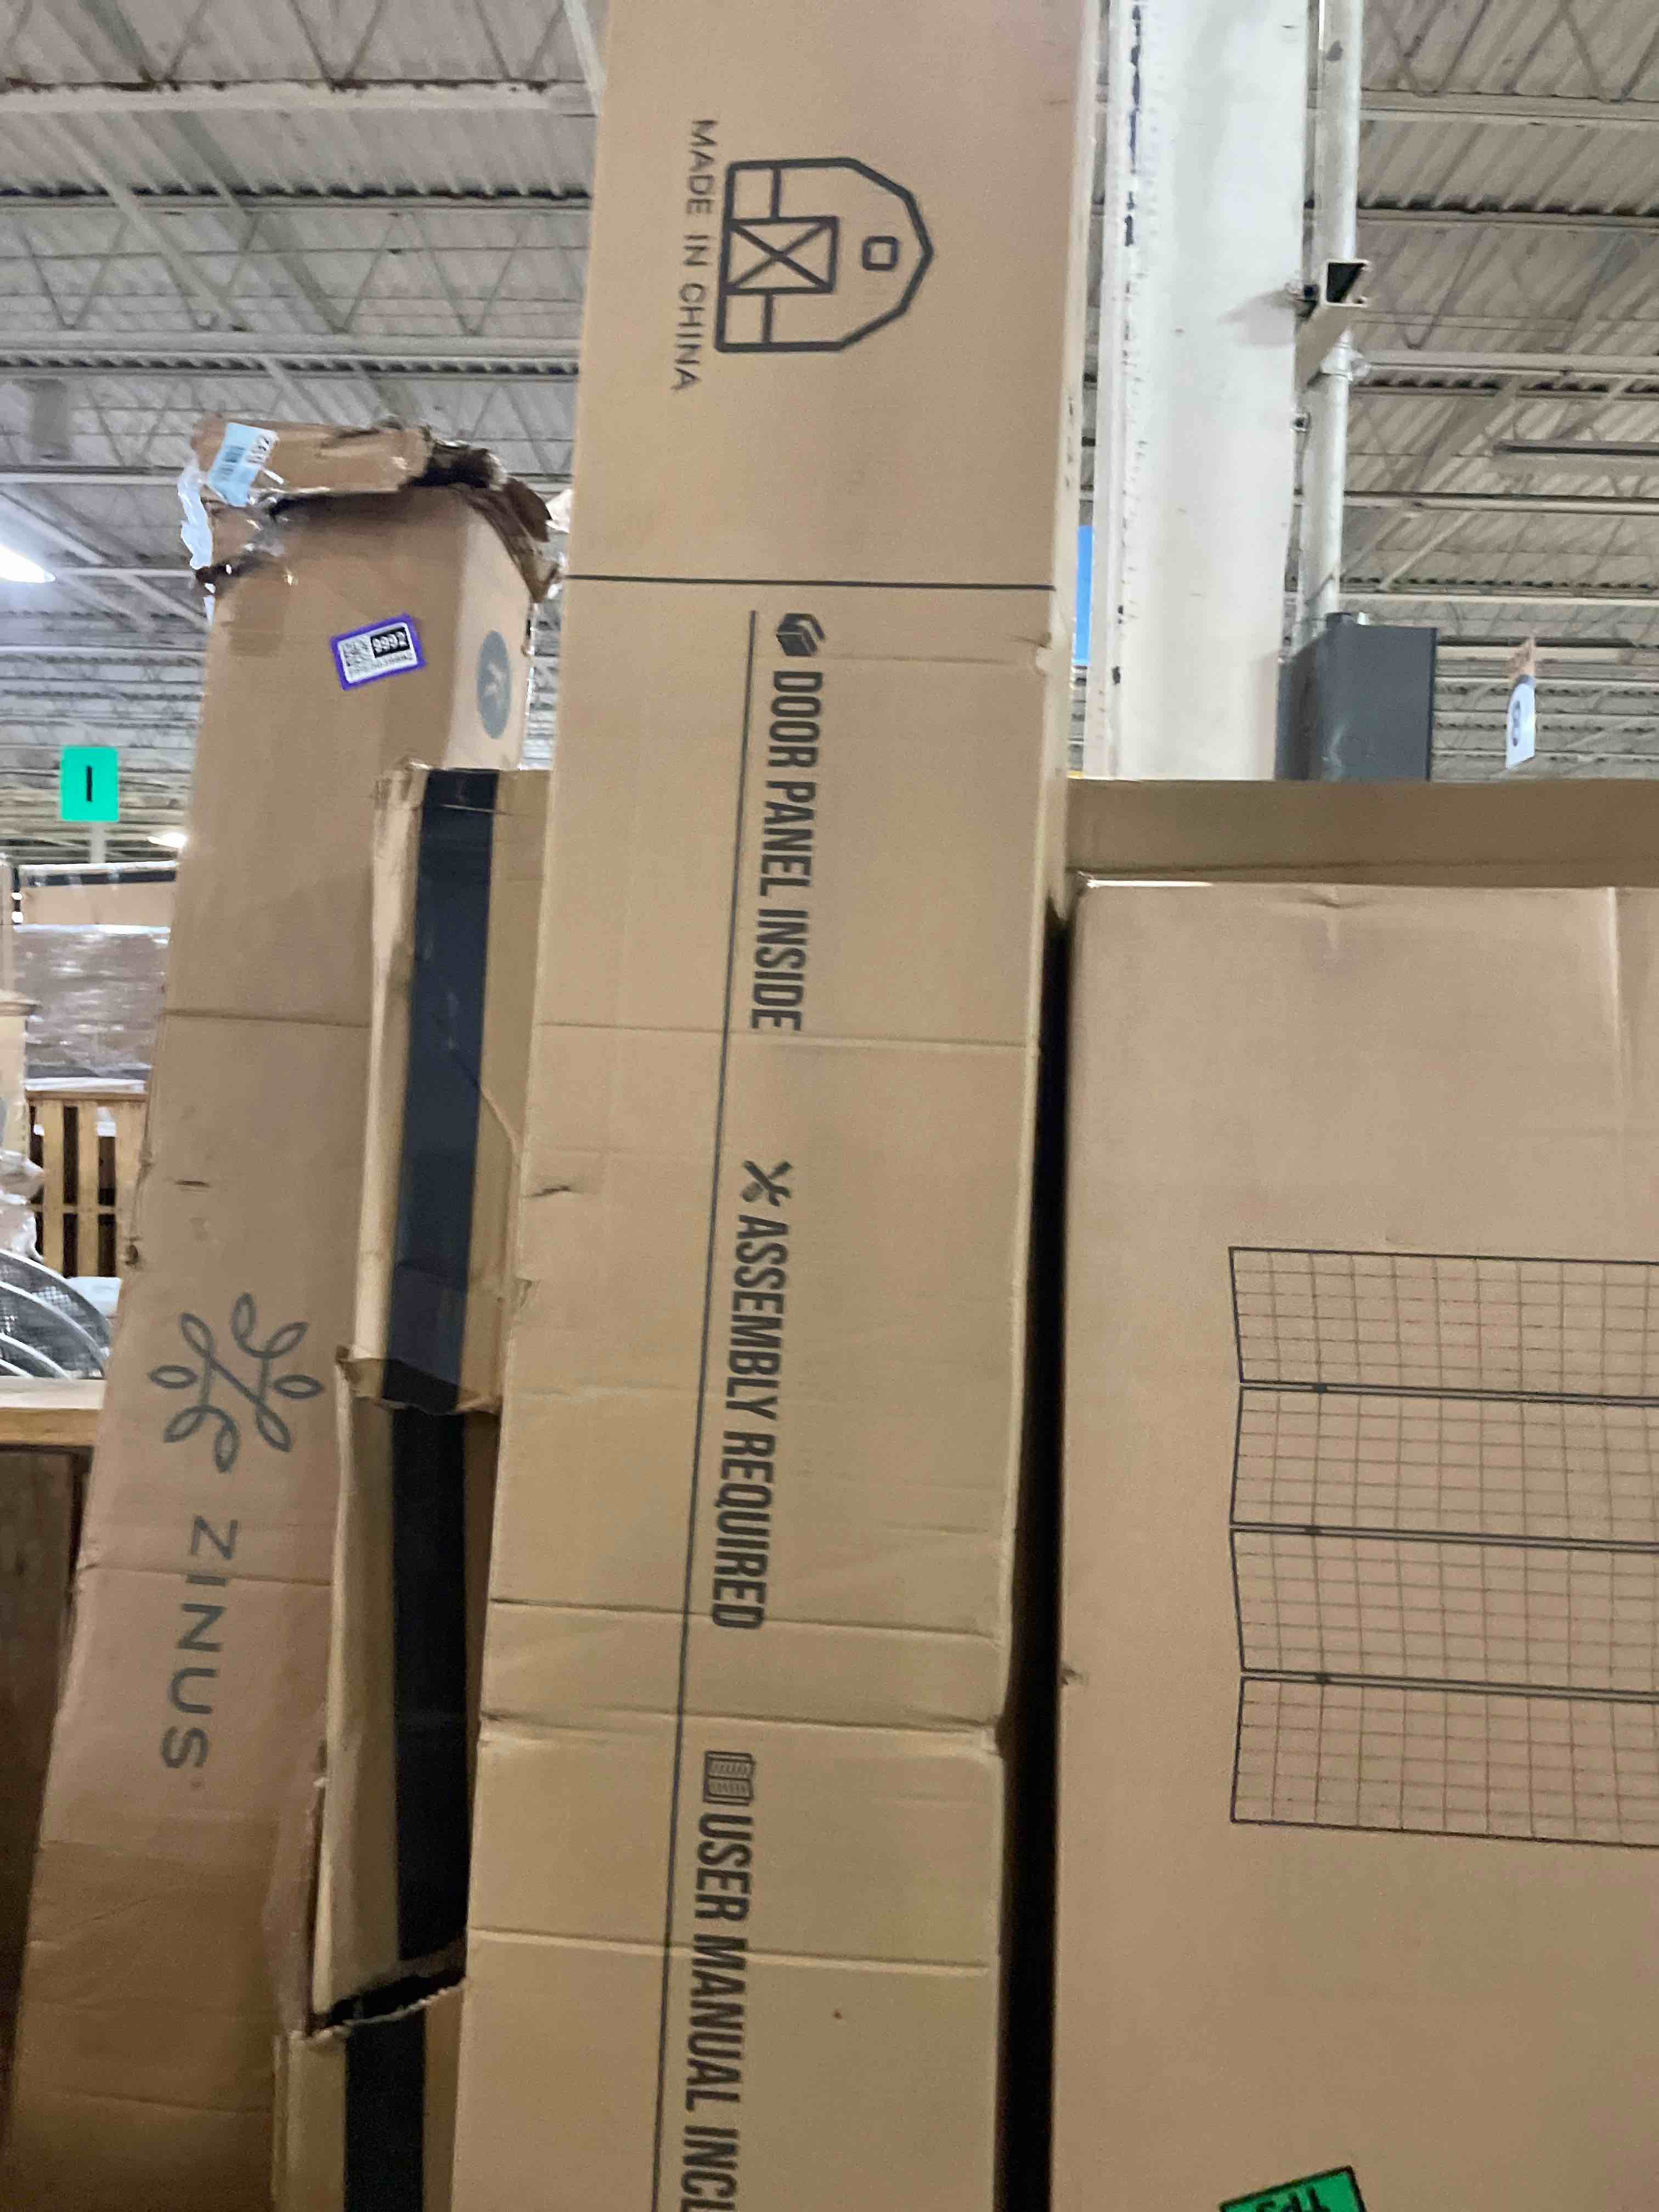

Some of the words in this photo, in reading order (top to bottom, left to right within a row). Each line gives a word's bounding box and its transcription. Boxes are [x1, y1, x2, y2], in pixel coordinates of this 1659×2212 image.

[686, 119, 718, 215] MADE
[682, 234, 710, 267] IN
[672, 283, 707, 391] CHINA
[767, 670, 824, 769] DOOR
[759, 780, 817, 897] PANEL
[751, 908, 809, 1032] INSIDE
[725, 1214, 789, 1421] ASSEMBLY
[713, 1431, 776, 1630] REQUIRED
[160, 1515, 239, 1770] ZINUS
[694, 1813, 753, 1922] USER
[685, 1933, 747, 2113] MANUAL
